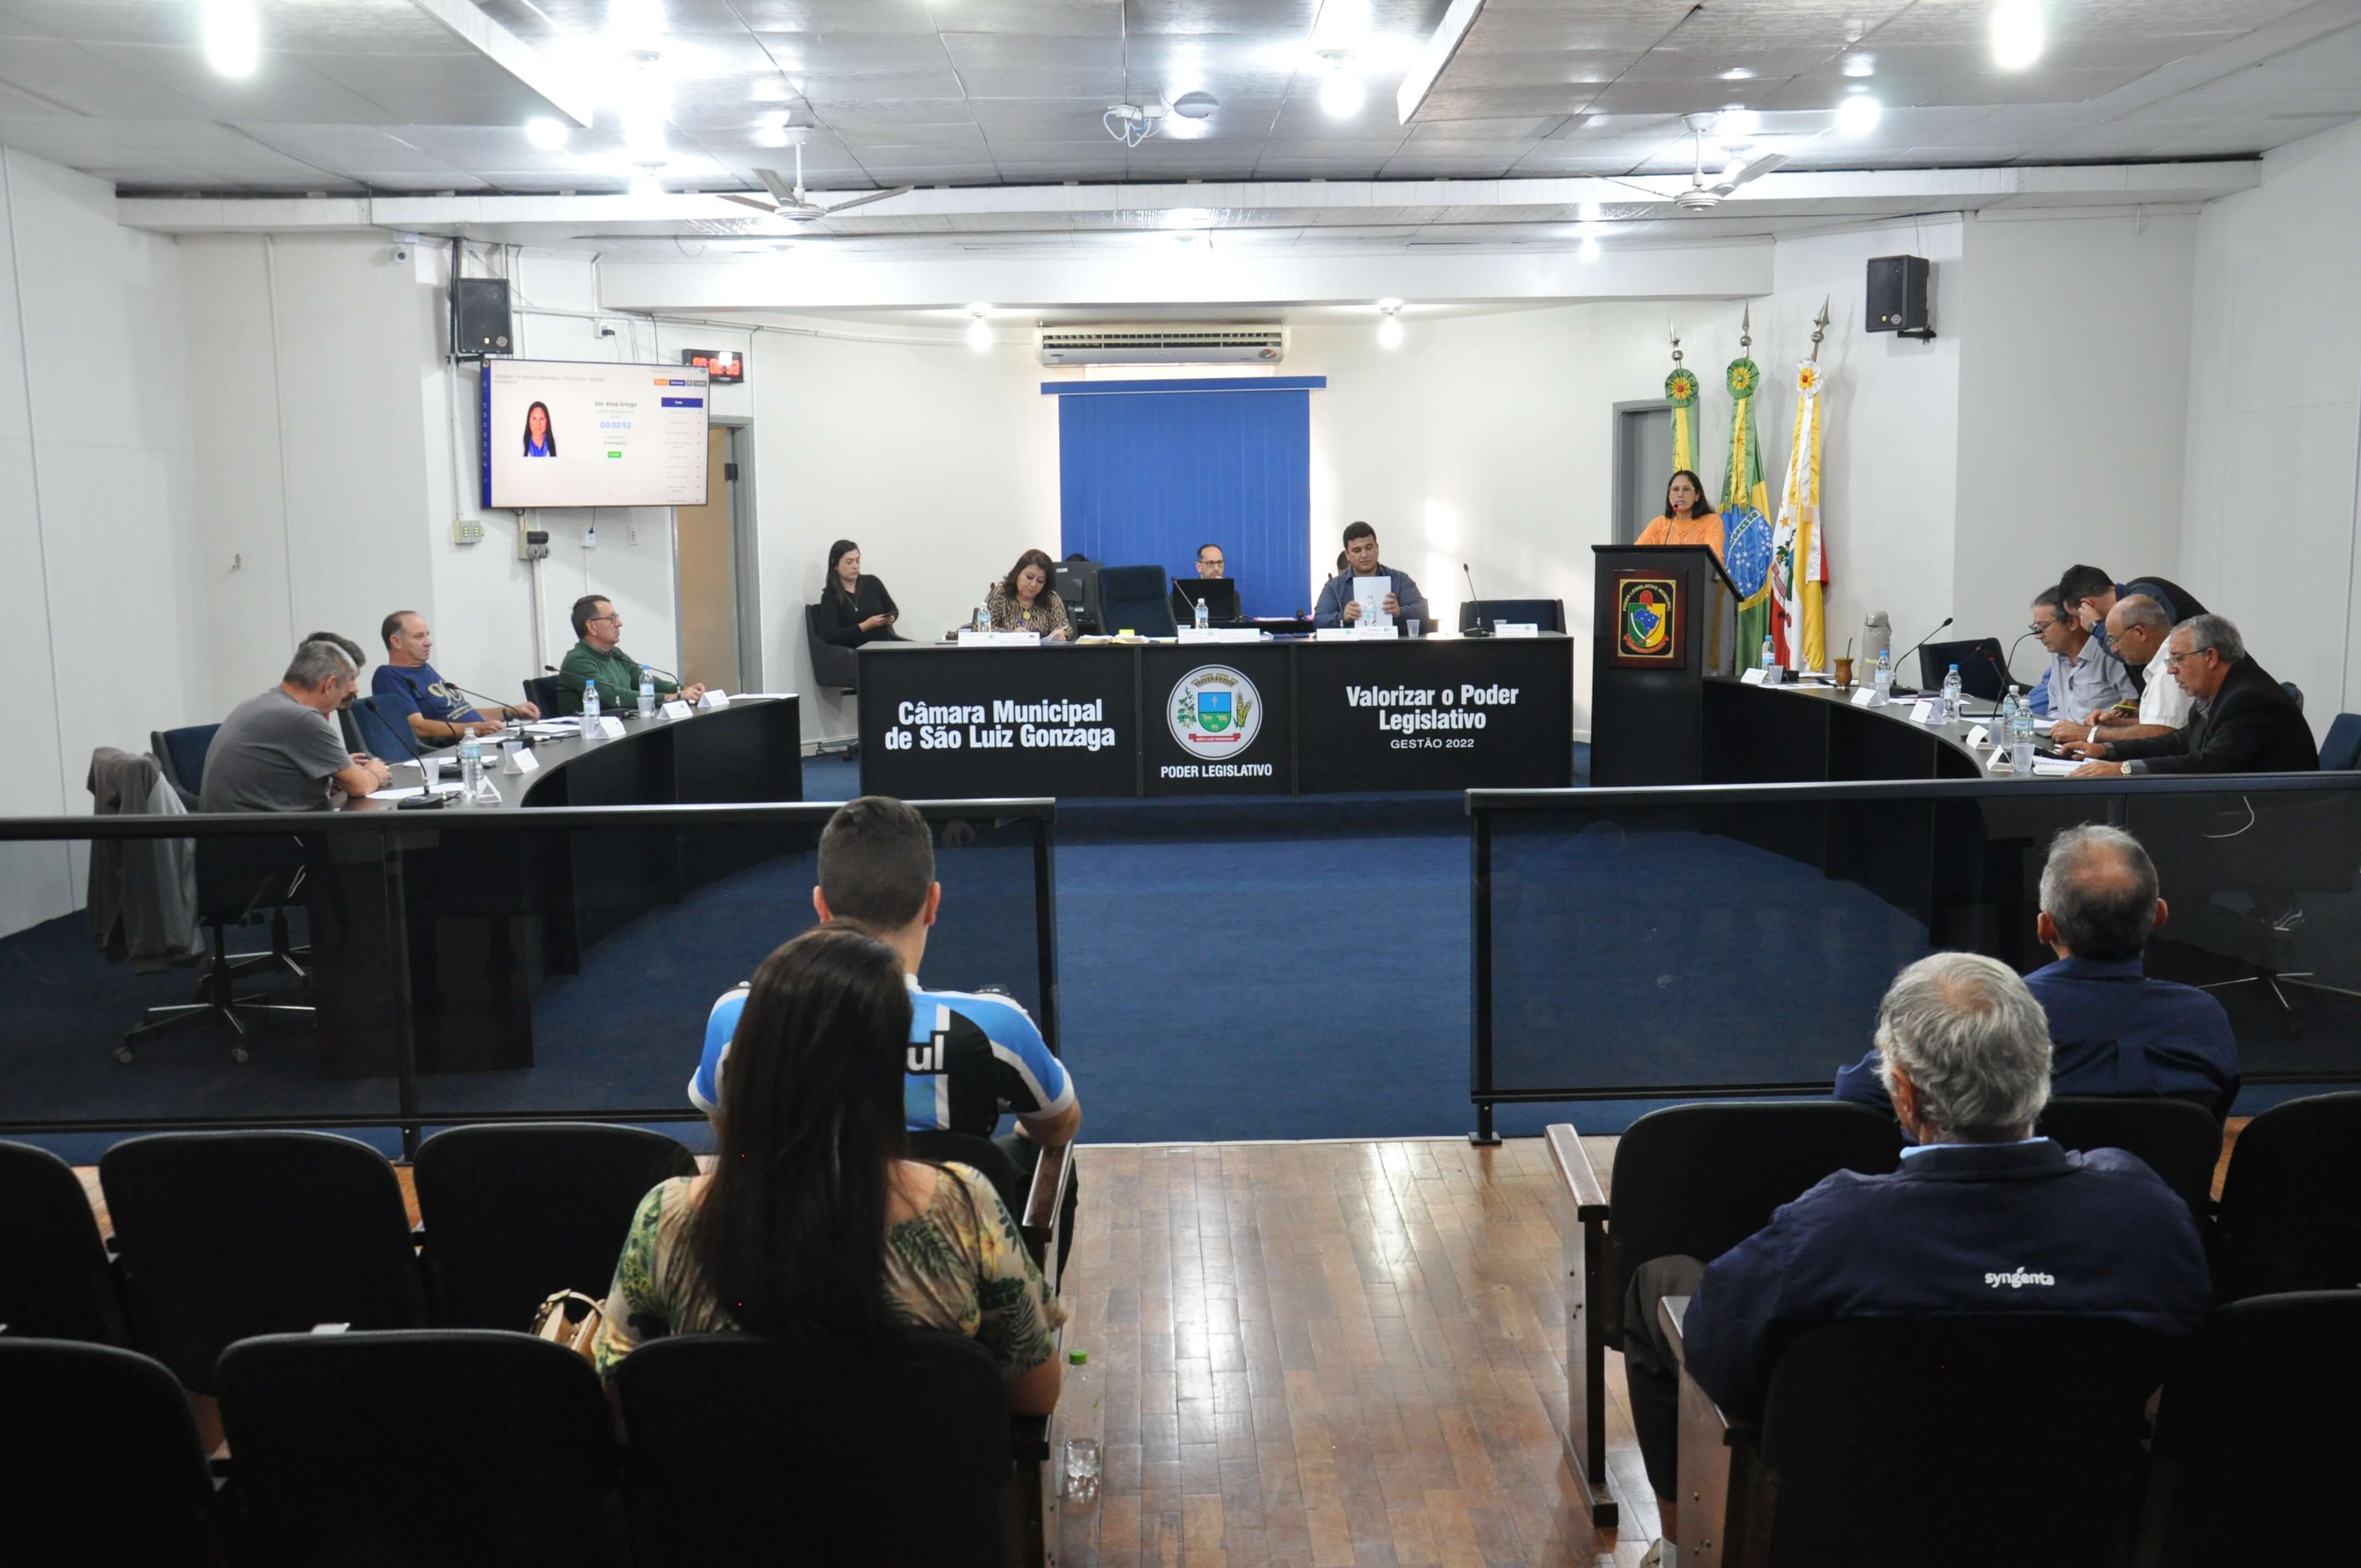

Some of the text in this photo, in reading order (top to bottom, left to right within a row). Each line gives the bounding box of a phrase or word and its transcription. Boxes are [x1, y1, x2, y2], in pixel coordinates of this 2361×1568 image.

[1346, 684, 1519, 707] Valorizar o Poder
[898, 698, 1102, 727] Câmara Municipal
[1379, 708, 1487, 734] Legislativo
[885, 723, 1116, 752] de São Luiz Gonzaga
[1390, 737, 1475, 749] GESTÃO 2022
[1161, 764, 1272, 778] PODER LEGISLATIVO
[1984, 1266, 2055, 1288] syngenta
